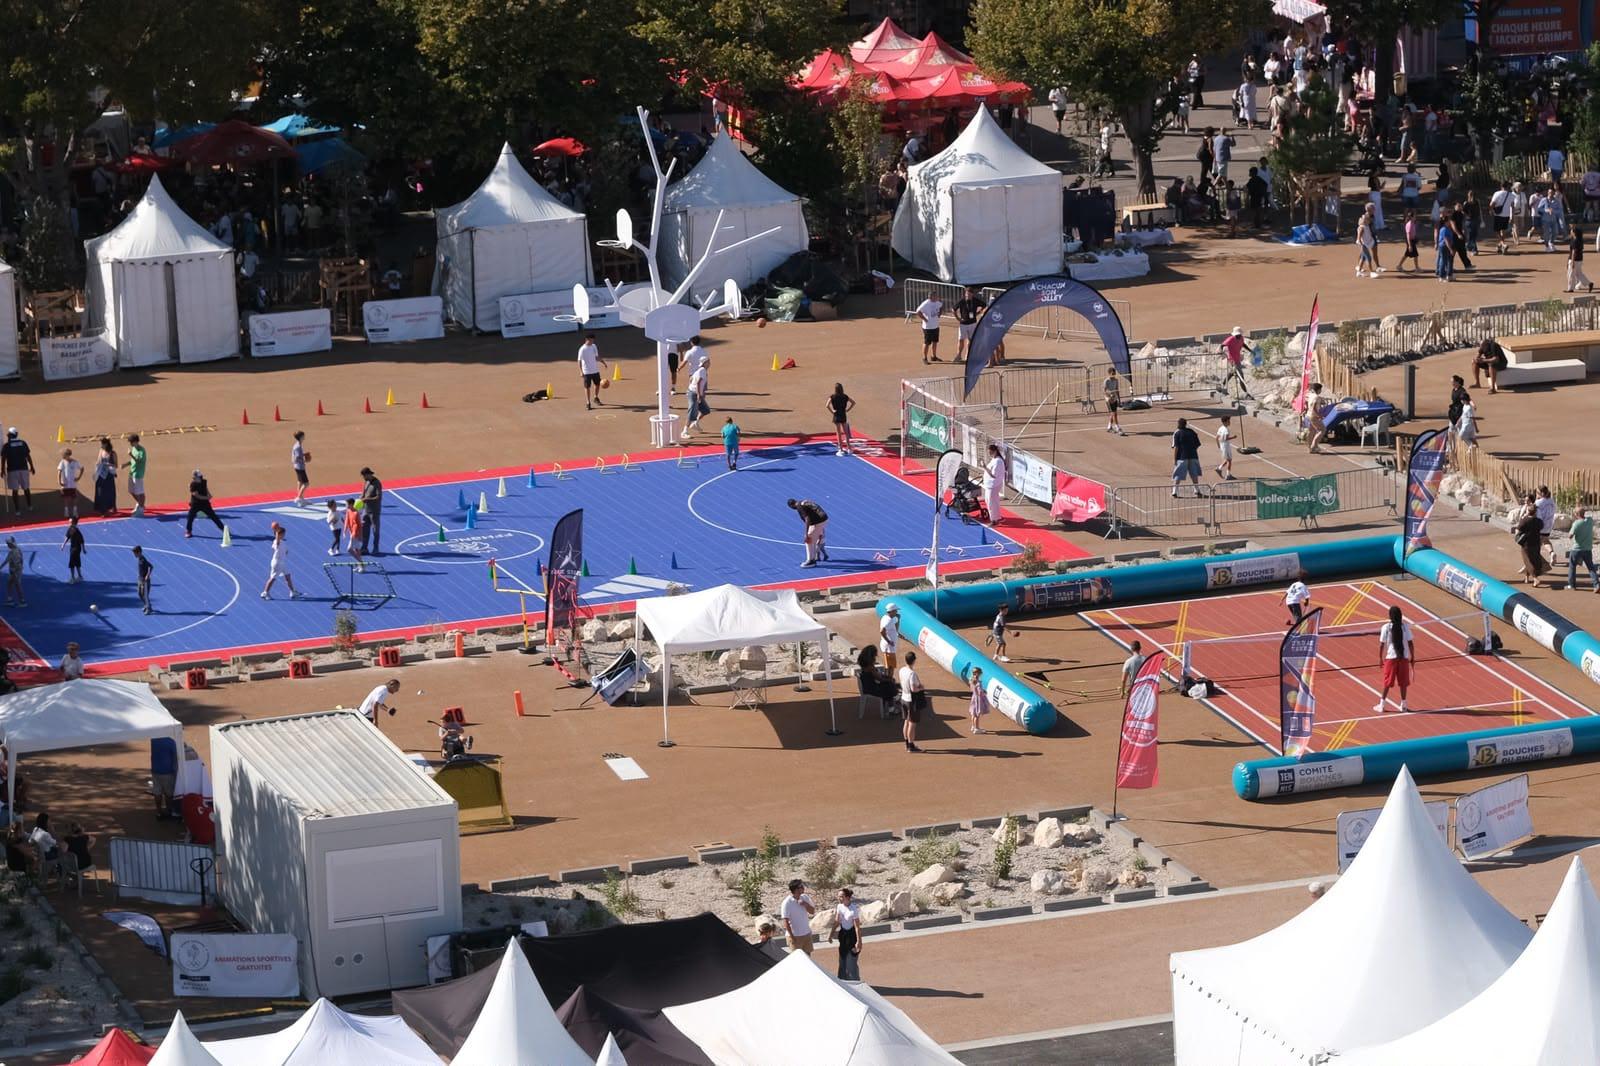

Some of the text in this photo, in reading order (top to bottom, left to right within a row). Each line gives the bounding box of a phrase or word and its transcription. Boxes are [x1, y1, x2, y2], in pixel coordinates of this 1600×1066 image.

[1491, 20, 1562, 33] CHAQUE HEURE
[1495, 33, 1535, 45] JACKPOT
[1537, 31, 1573, 42] GRIMPE
[1258, 493, 1290, 504] volley
[1236, 567, 1275, 578] BOUCHES
[382, 649, 399, 665] 10
[292, 660, 309, 677] 20
[189, 670, 205, 687] 30
[1502, 744, 1545, 757] BOUCHES
